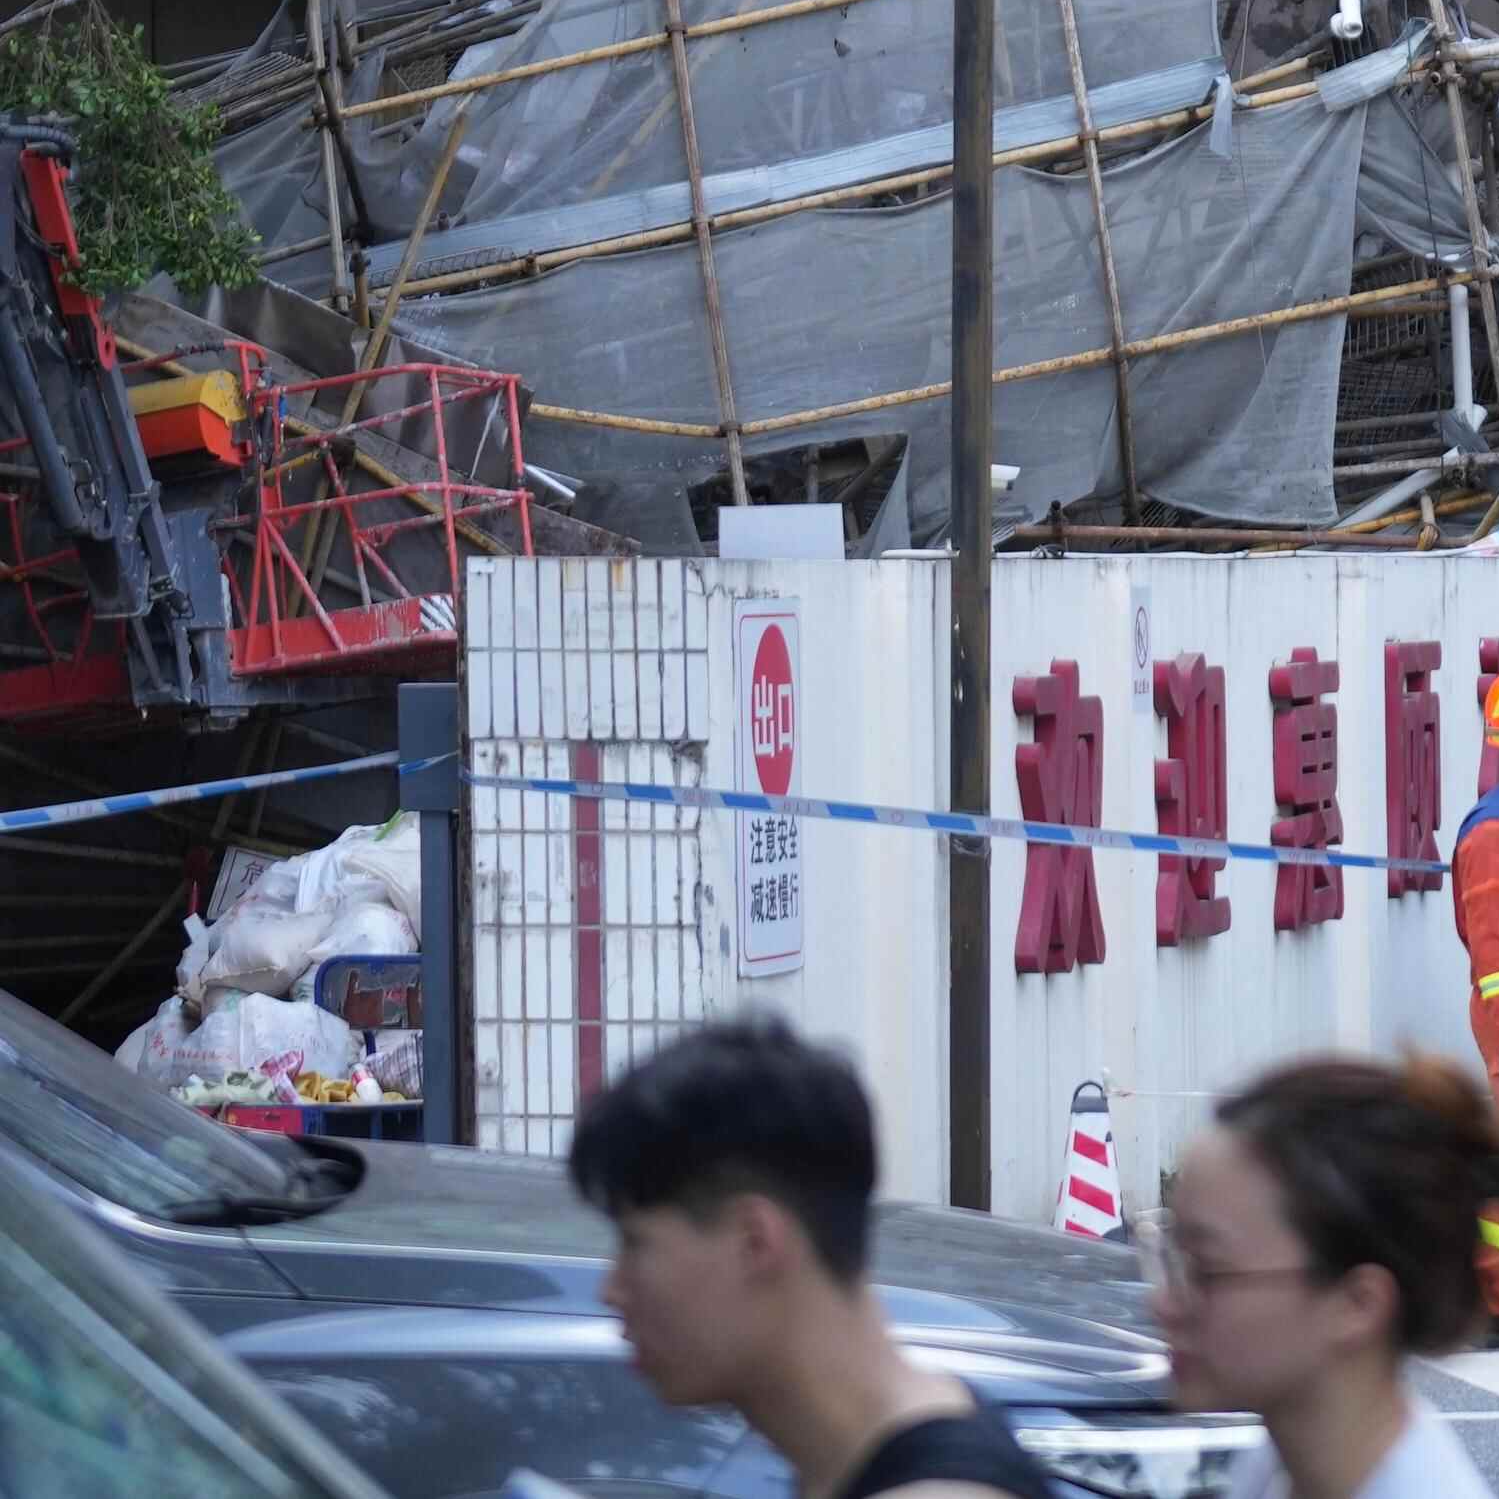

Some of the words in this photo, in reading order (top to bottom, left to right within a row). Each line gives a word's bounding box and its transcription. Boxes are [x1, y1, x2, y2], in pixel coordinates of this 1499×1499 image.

[754, 674, 794, 758] 出口
[749, 813, 798, 865] 注意安全
[749, 872, 799, 923] 减速慢行
